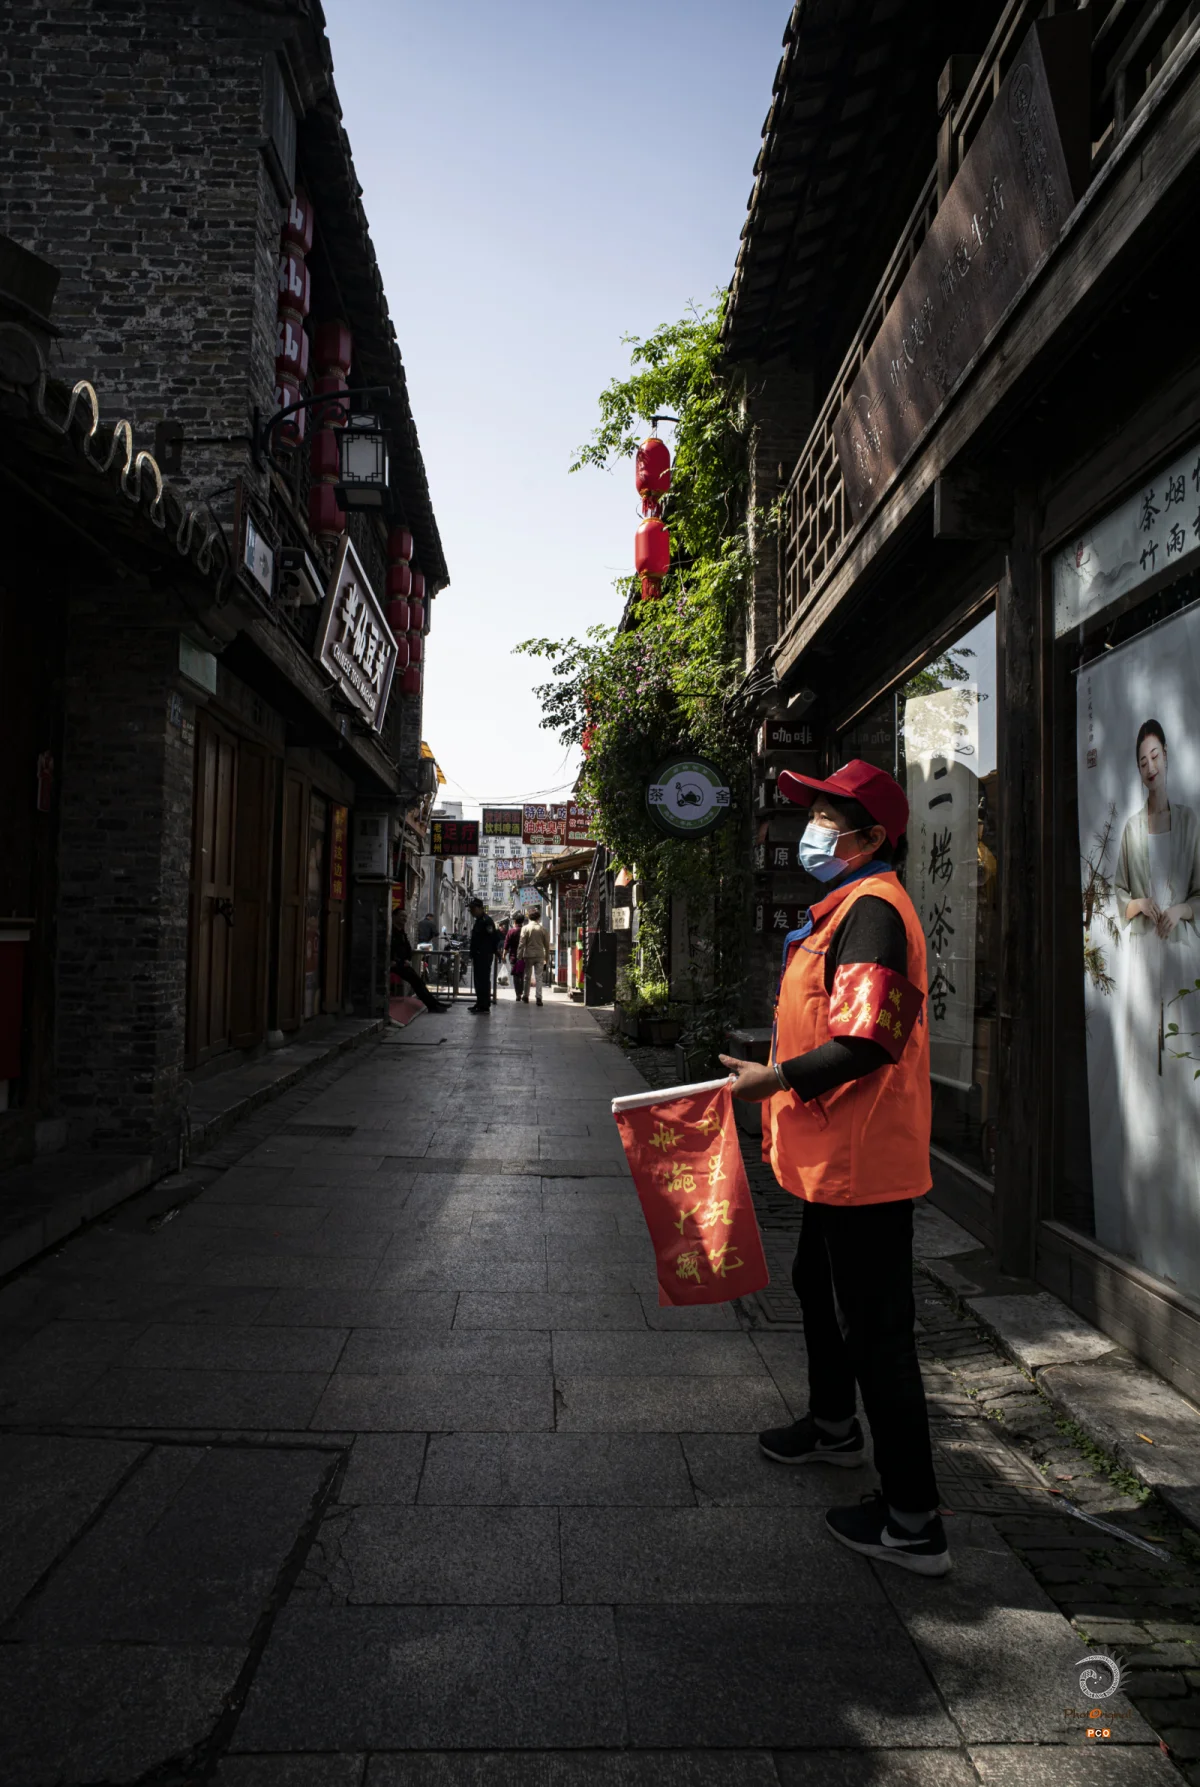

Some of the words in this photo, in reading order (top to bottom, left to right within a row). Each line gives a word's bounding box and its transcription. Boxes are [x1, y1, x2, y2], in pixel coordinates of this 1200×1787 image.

[1140, 506, 1200, 571] 竹雨
[772, 725, 812, 744] 咖啡
[650, 788, 664, 802] 茶
[716, 789, 730, 804] 舍
[444, 823, 476, 841] 足疗
[524, 820, 566, 834] 油炸臭干
